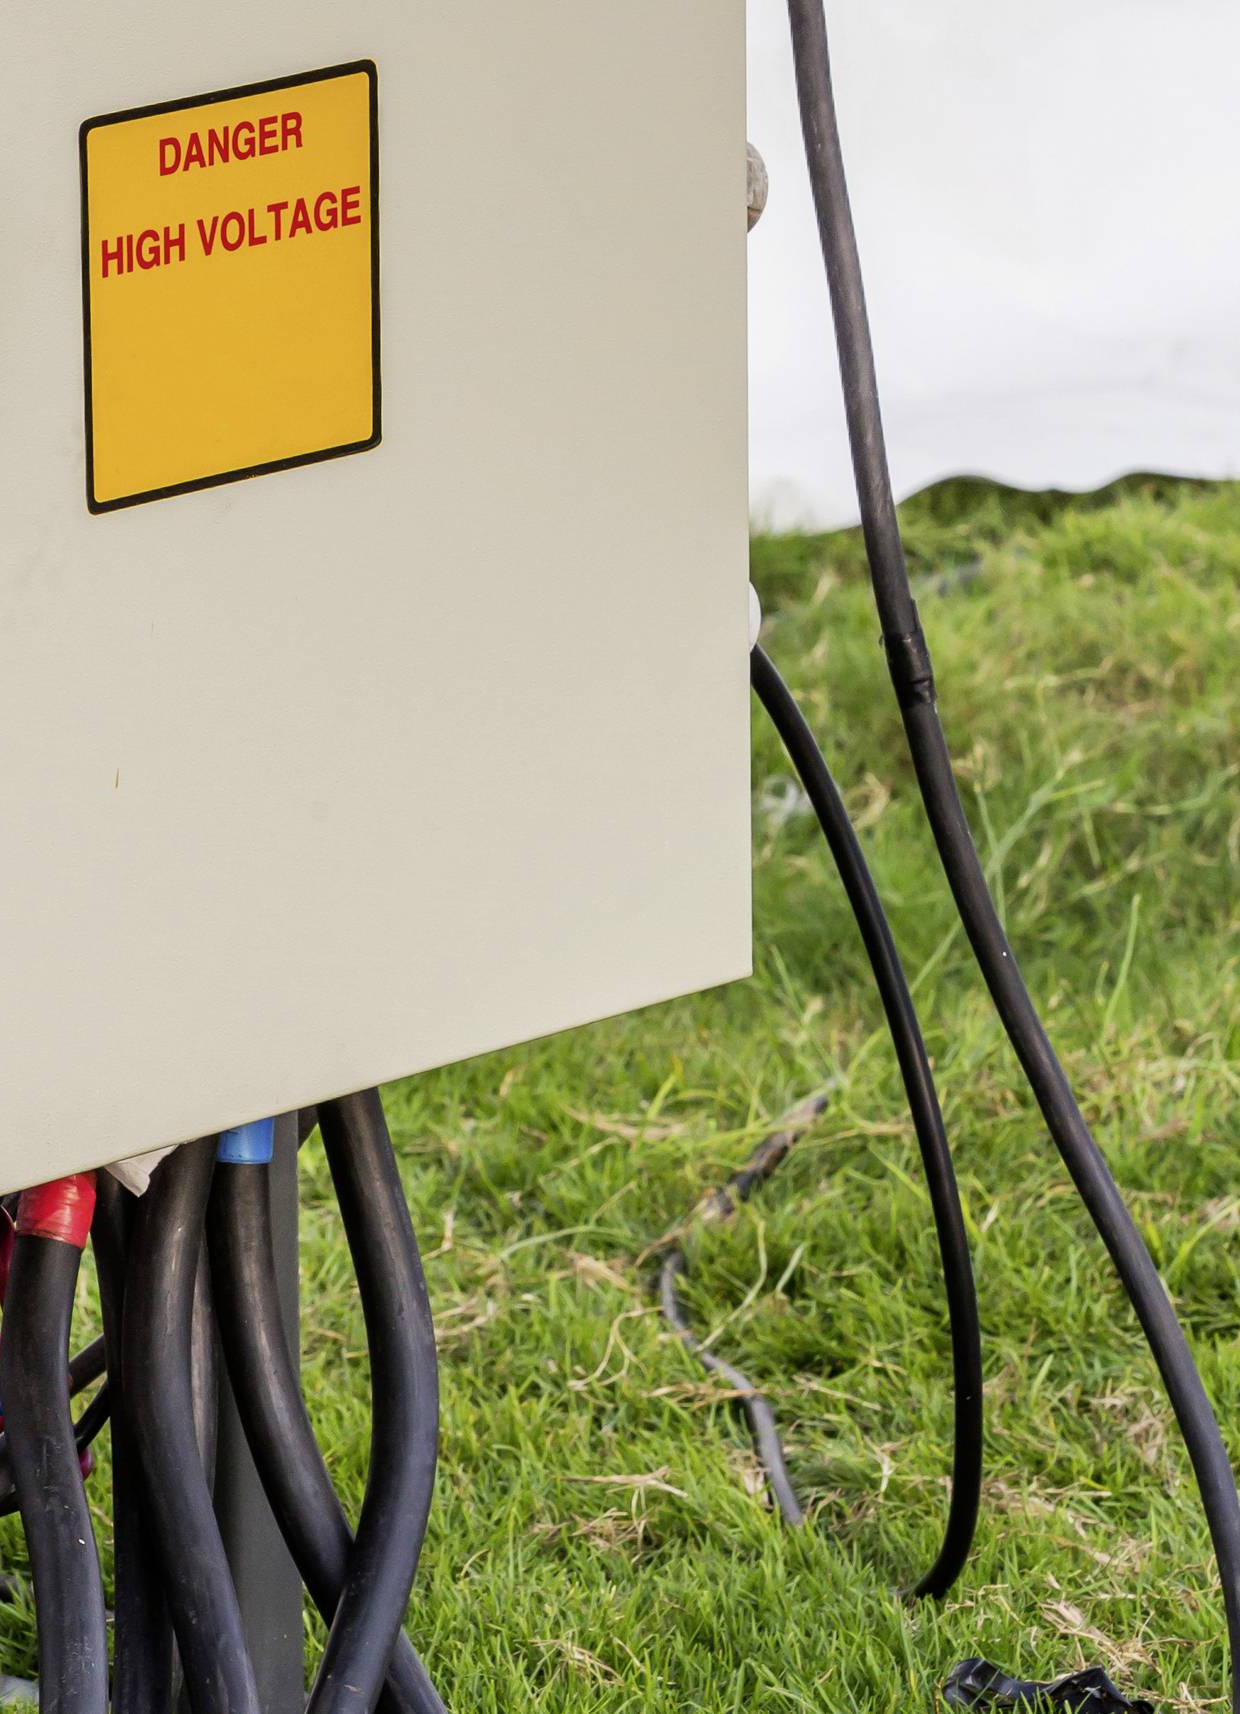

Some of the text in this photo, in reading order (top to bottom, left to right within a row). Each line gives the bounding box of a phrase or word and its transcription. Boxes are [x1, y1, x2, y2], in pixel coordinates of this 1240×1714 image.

[159, 112, 303, 176] DANGER
[101, 186, 361, 278] HIGH VOLTAGE
